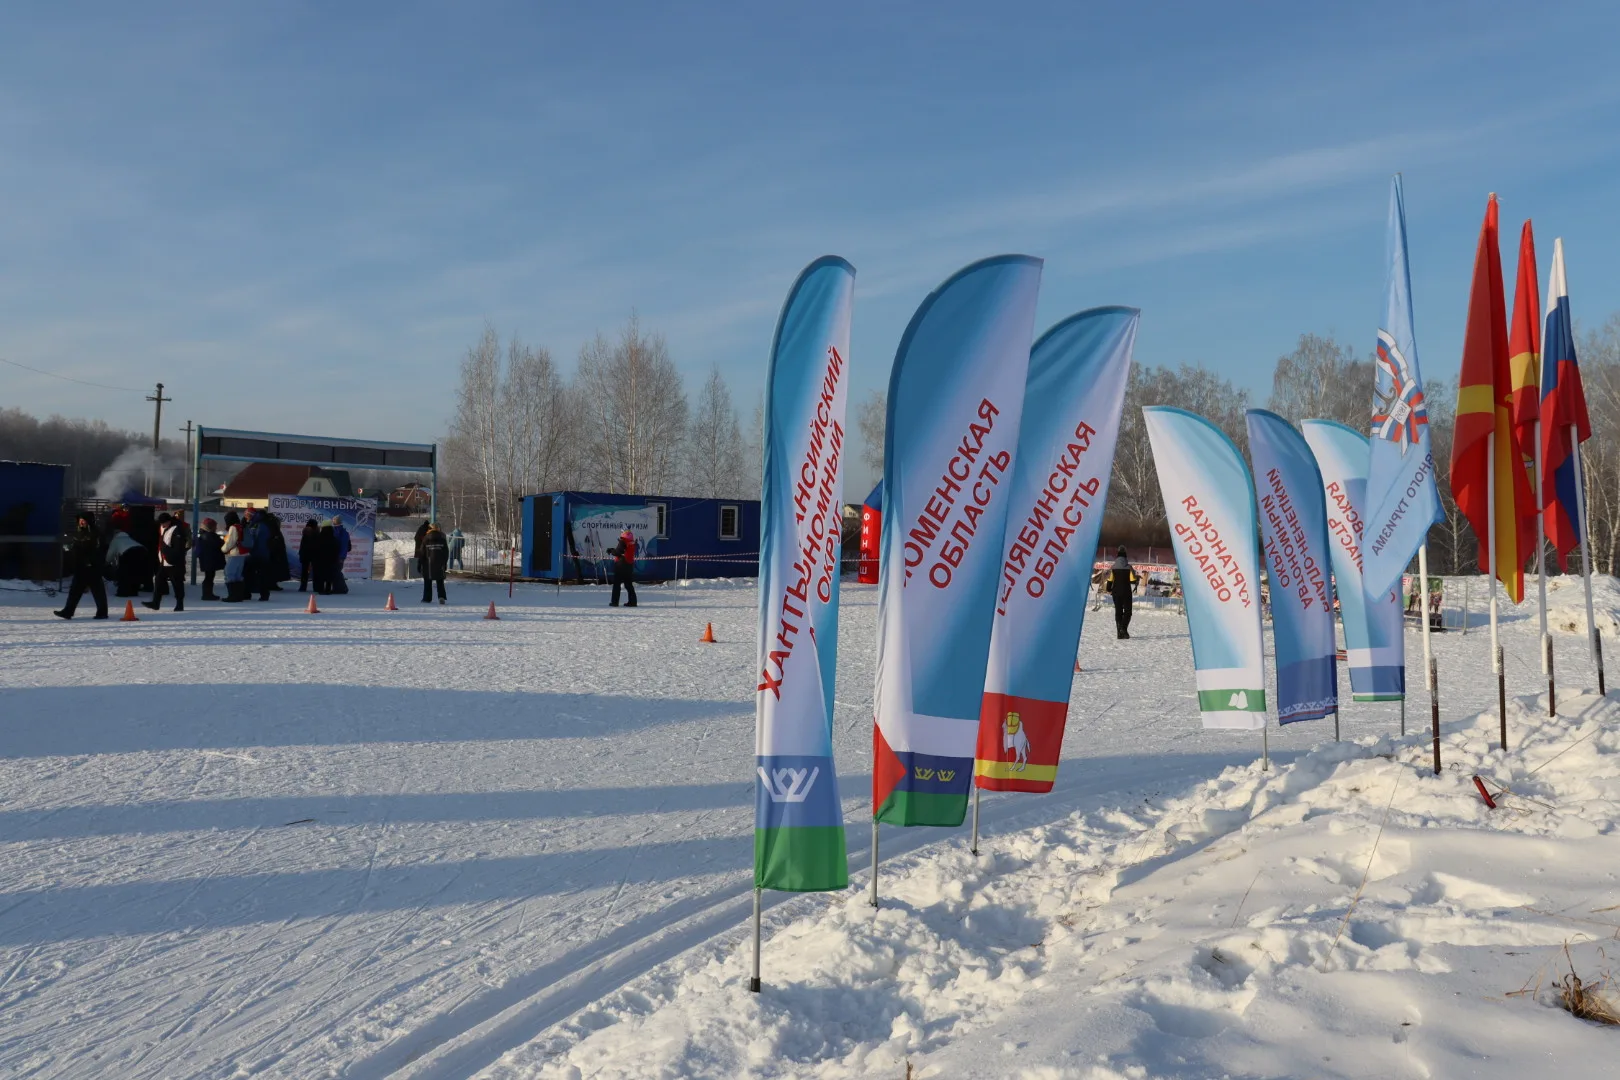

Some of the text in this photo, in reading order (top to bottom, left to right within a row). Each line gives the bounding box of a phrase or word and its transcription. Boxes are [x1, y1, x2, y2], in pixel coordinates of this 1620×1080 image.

[272, 498, 357, 510] СПОРТИВНЫЙ
[582, 521, 623, 529] СПОРТИВНЫЙ
[860, 512, 870, 575] ФИНИШ
[929, 450, 1010, 589] ОБЛАСТЬ
[1026, 477, 1099, 598] ОБЛАСТЬ
[817, 500, 843, 602] ОКРУГ
